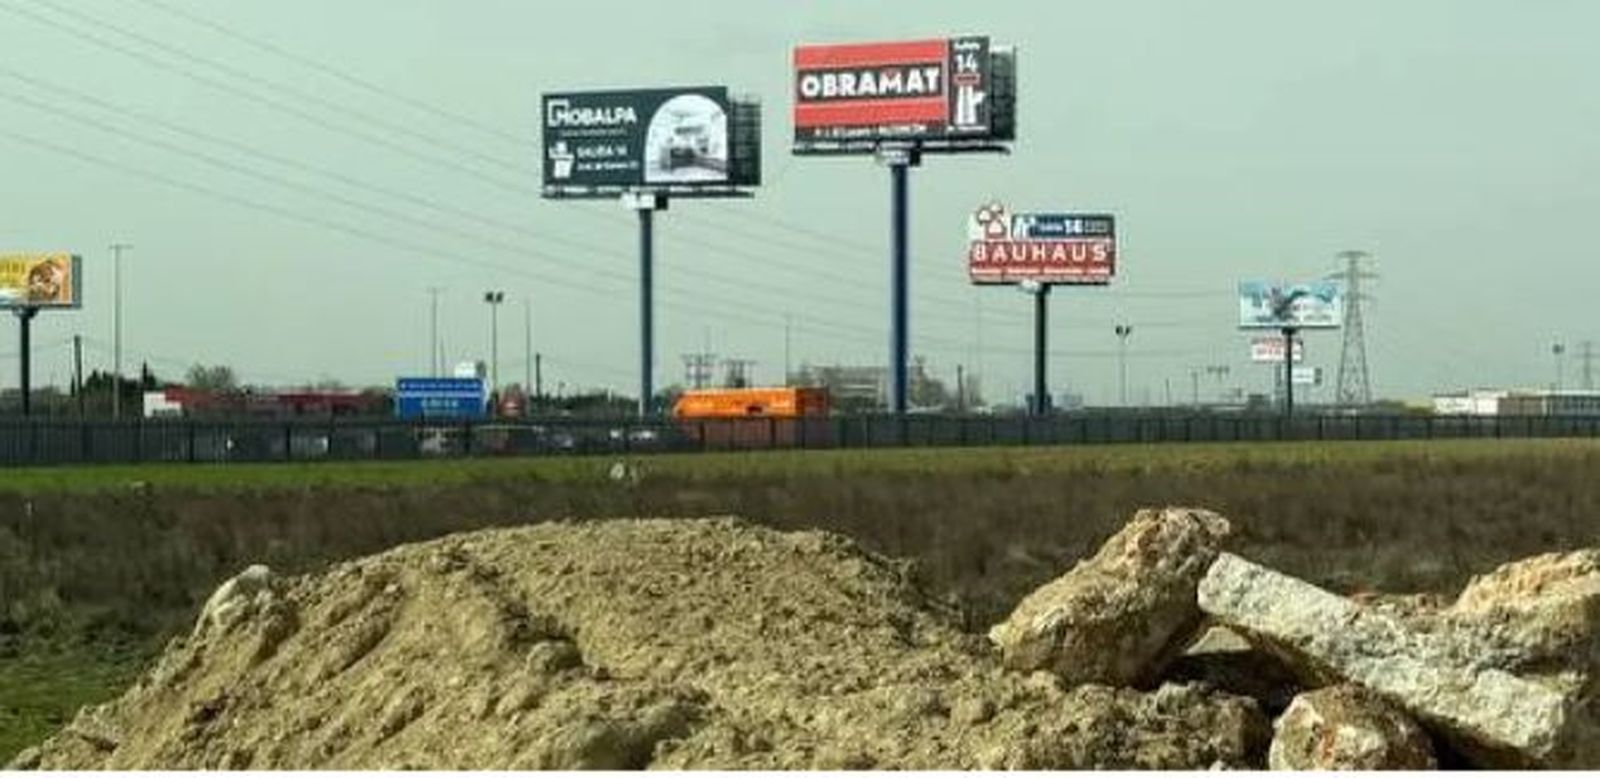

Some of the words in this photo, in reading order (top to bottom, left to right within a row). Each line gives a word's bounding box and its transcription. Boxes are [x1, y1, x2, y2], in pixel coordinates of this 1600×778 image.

[956, 53, 977, 72] 14
[801, 67, 940, 97] OBRAMAT
[548, 100, 637, 127] MOBALPA
[974, 243, 1108, 263] BAUHAUS
